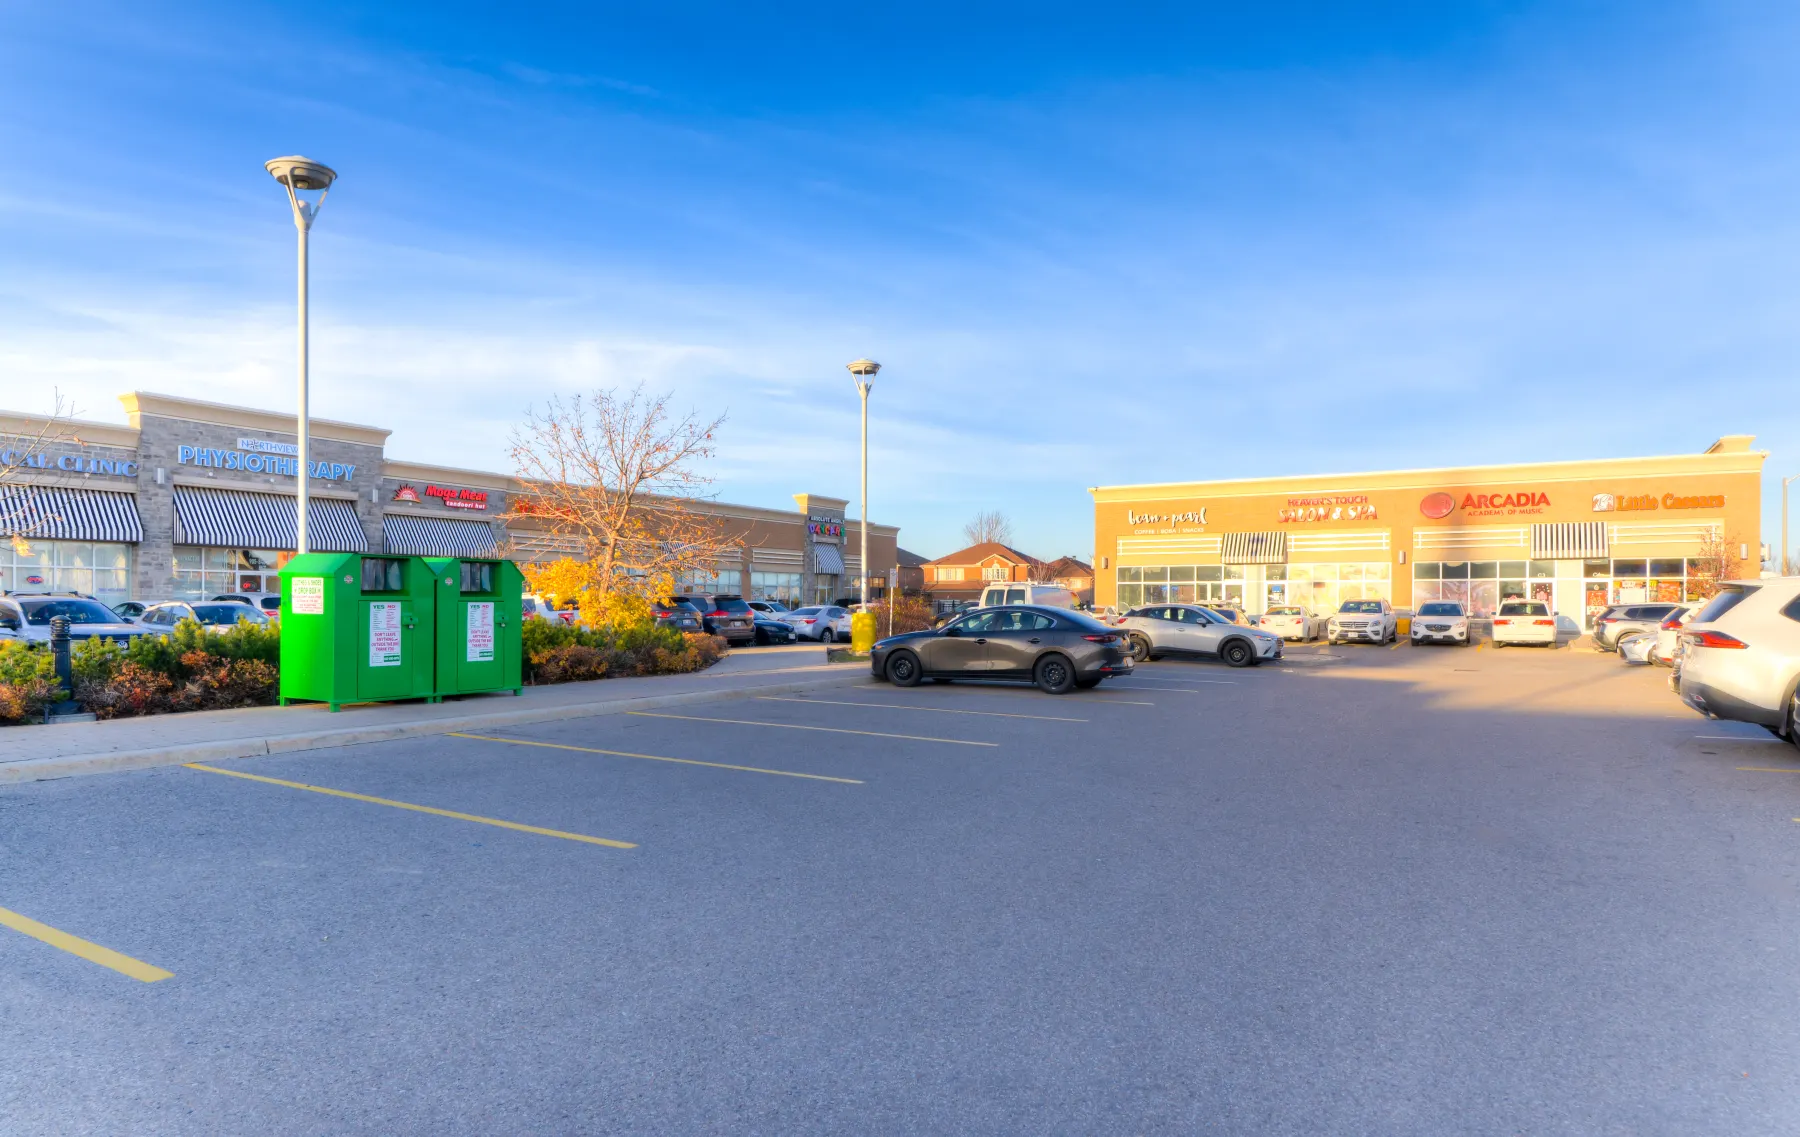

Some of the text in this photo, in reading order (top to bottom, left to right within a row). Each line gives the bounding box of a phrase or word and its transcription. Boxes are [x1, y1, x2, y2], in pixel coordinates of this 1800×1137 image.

[58, 455, 138, 477] CLINIC
[178, 445, 356, 481] PHYSIOTHERAPY
[425, 485, 457, 501] Moga
[460, 489, 488, 501] Meat
[1287, 495, 1368, 507] HEAVEN'S TOUCH
[1460, 492, 1551, 509] ARCADIA
[1128, 509, 1161, 525] bean
[1171, 506, 1208, 528] pearl
[1277, 504, 1378, 523] SALON & SPA
[1467, 509, 1505, 517] ACADEMY
[1518, 507, 1544, 515] MUSIC
[808, 523, 845, 536] DAYCARE
